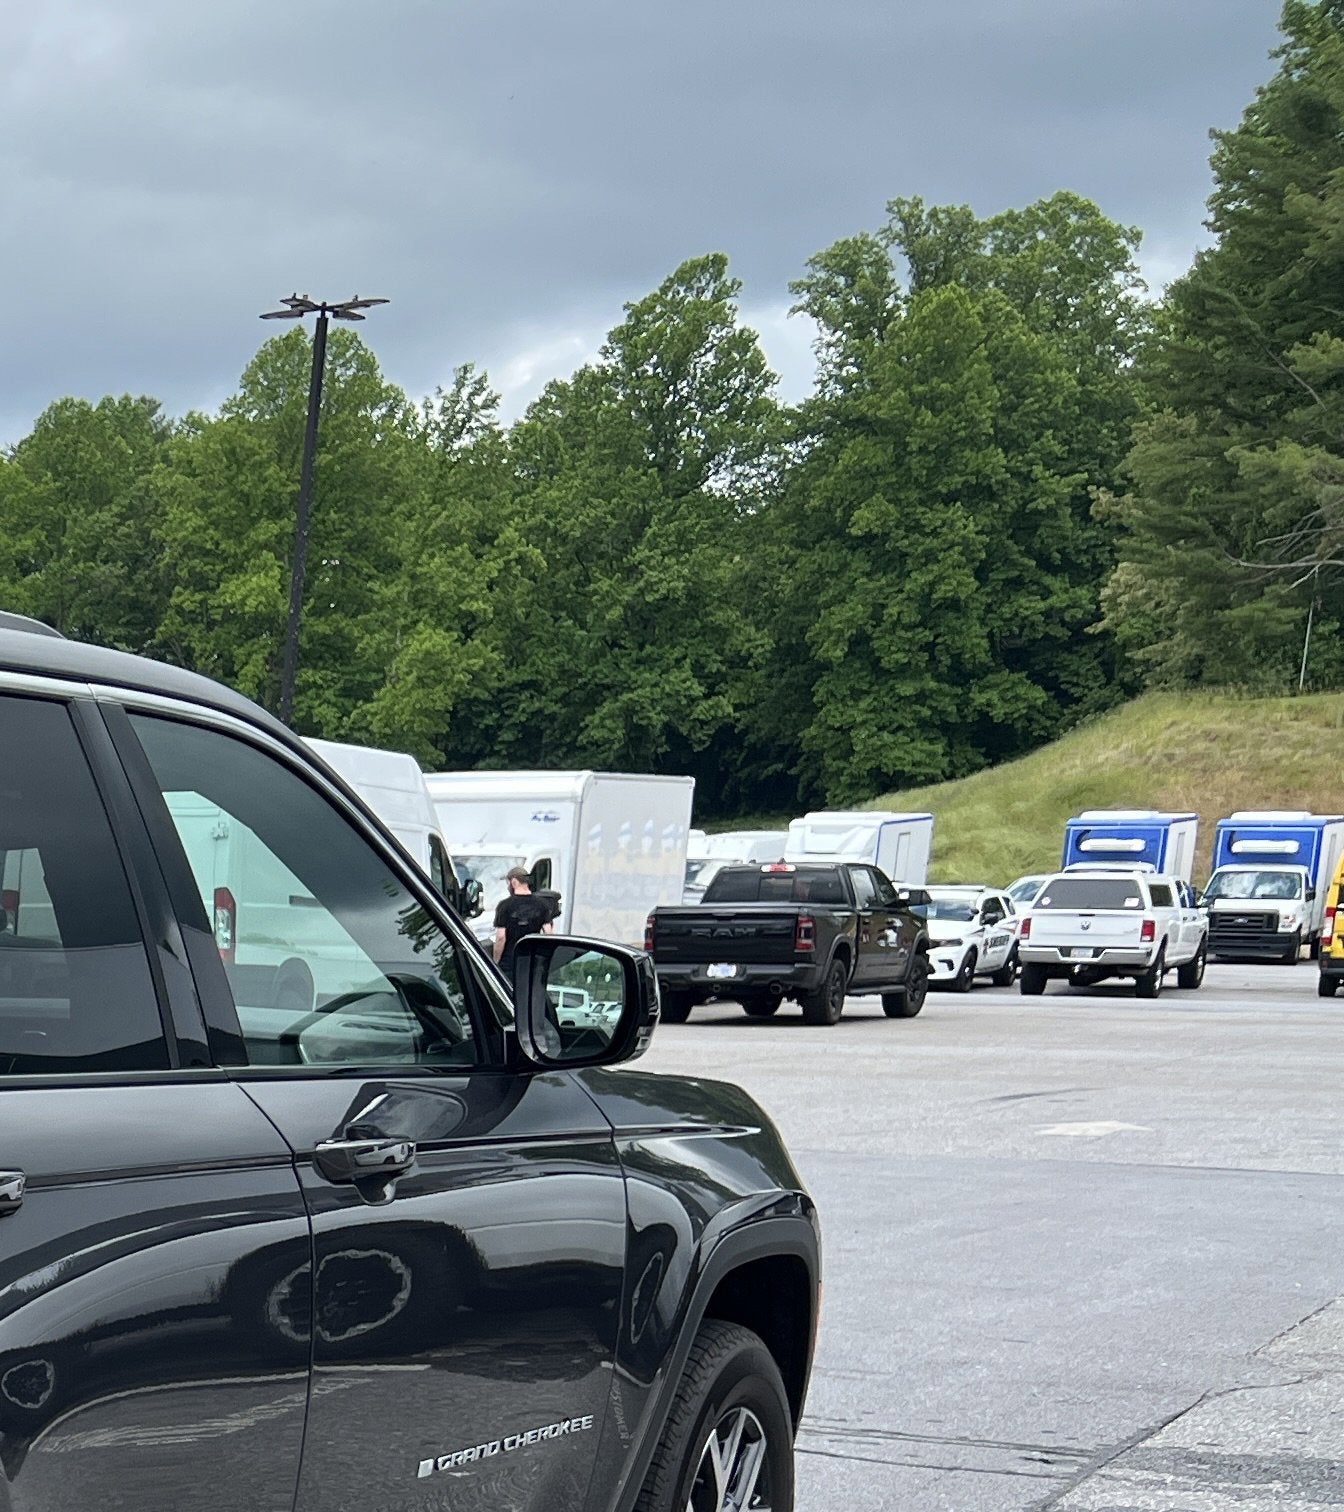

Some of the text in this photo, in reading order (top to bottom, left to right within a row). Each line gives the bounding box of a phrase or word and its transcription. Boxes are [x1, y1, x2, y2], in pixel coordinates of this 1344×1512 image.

[691, 927, 756, 939] RAM
[436, 1414, 594, 1471] GRAND CHEROKEE
